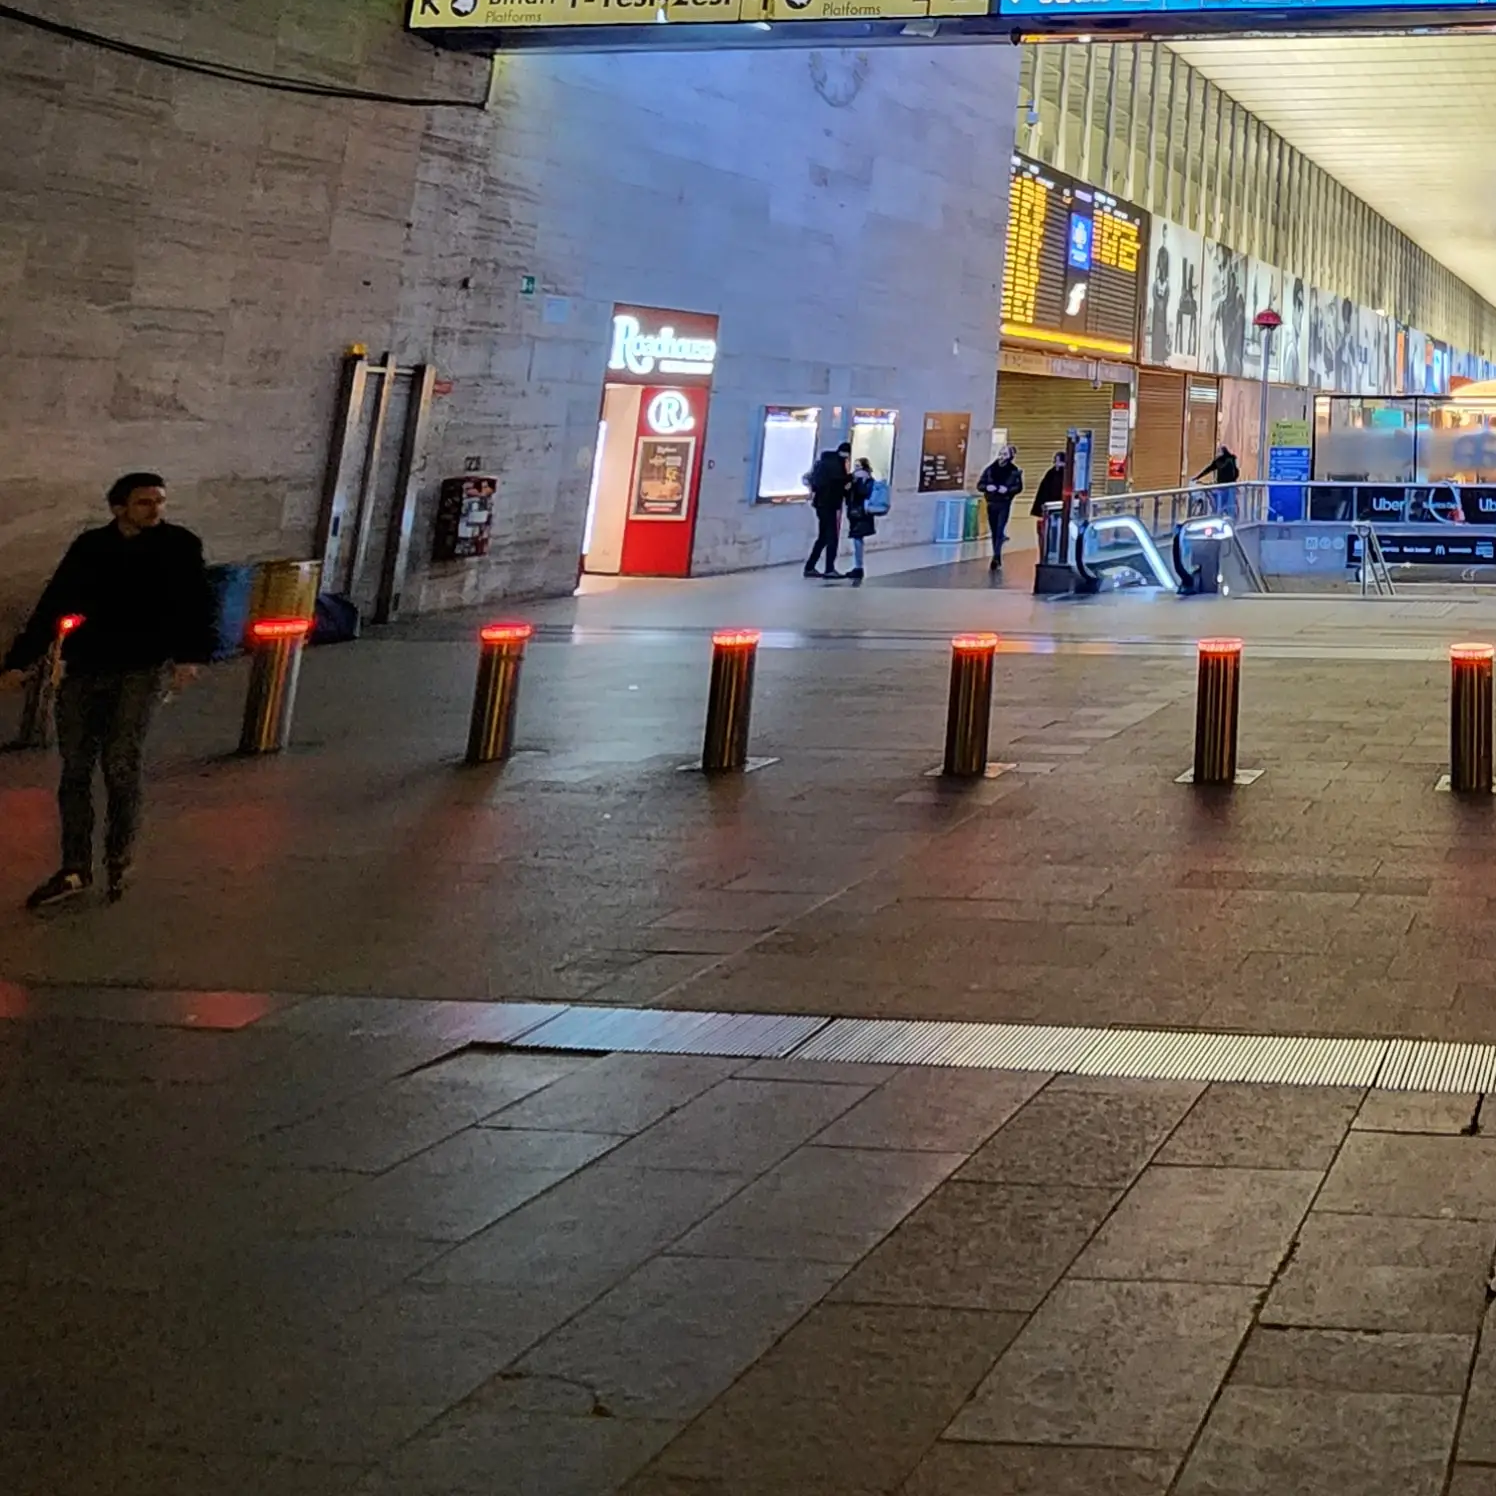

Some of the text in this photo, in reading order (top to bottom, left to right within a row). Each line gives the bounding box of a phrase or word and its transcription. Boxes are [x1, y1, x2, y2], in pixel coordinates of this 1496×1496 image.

[485, 10, 543, 24] Platforms
[822, 3, 882, 18] Platforms
[1372, 497, 1407, 512] Uber
